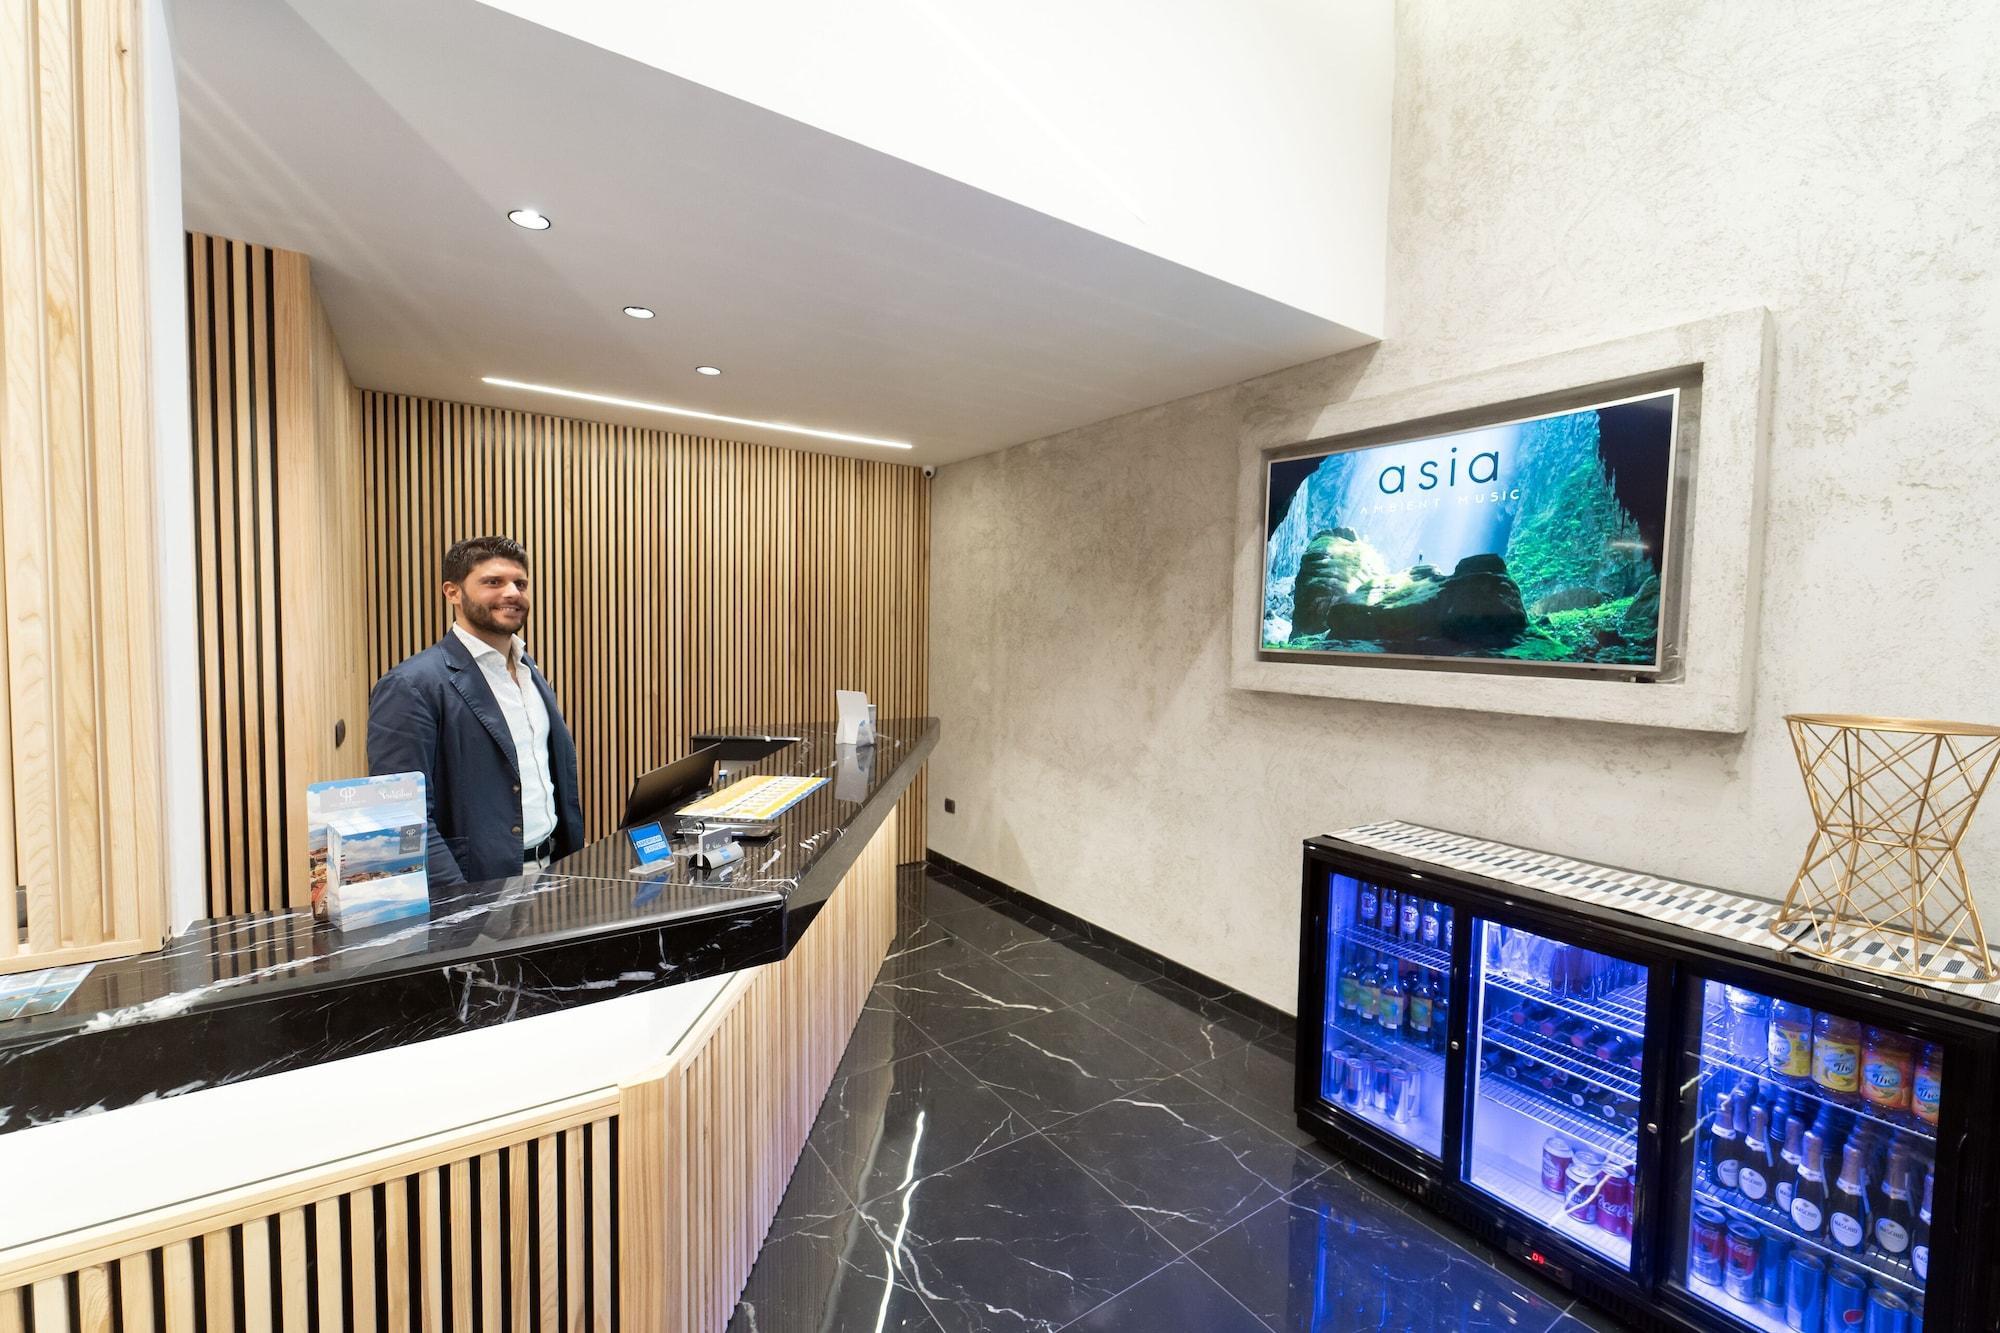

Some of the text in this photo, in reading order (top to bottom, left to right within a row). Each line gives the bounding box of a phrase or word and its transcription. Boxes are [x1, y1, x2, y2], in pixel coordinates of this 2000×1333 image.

[1379, 447, 1499, 494] asia
[1360, 489, 1520, 515] AMBIENT MUSIC
[1834, 1219, 1858, 1234] MASCHIO
